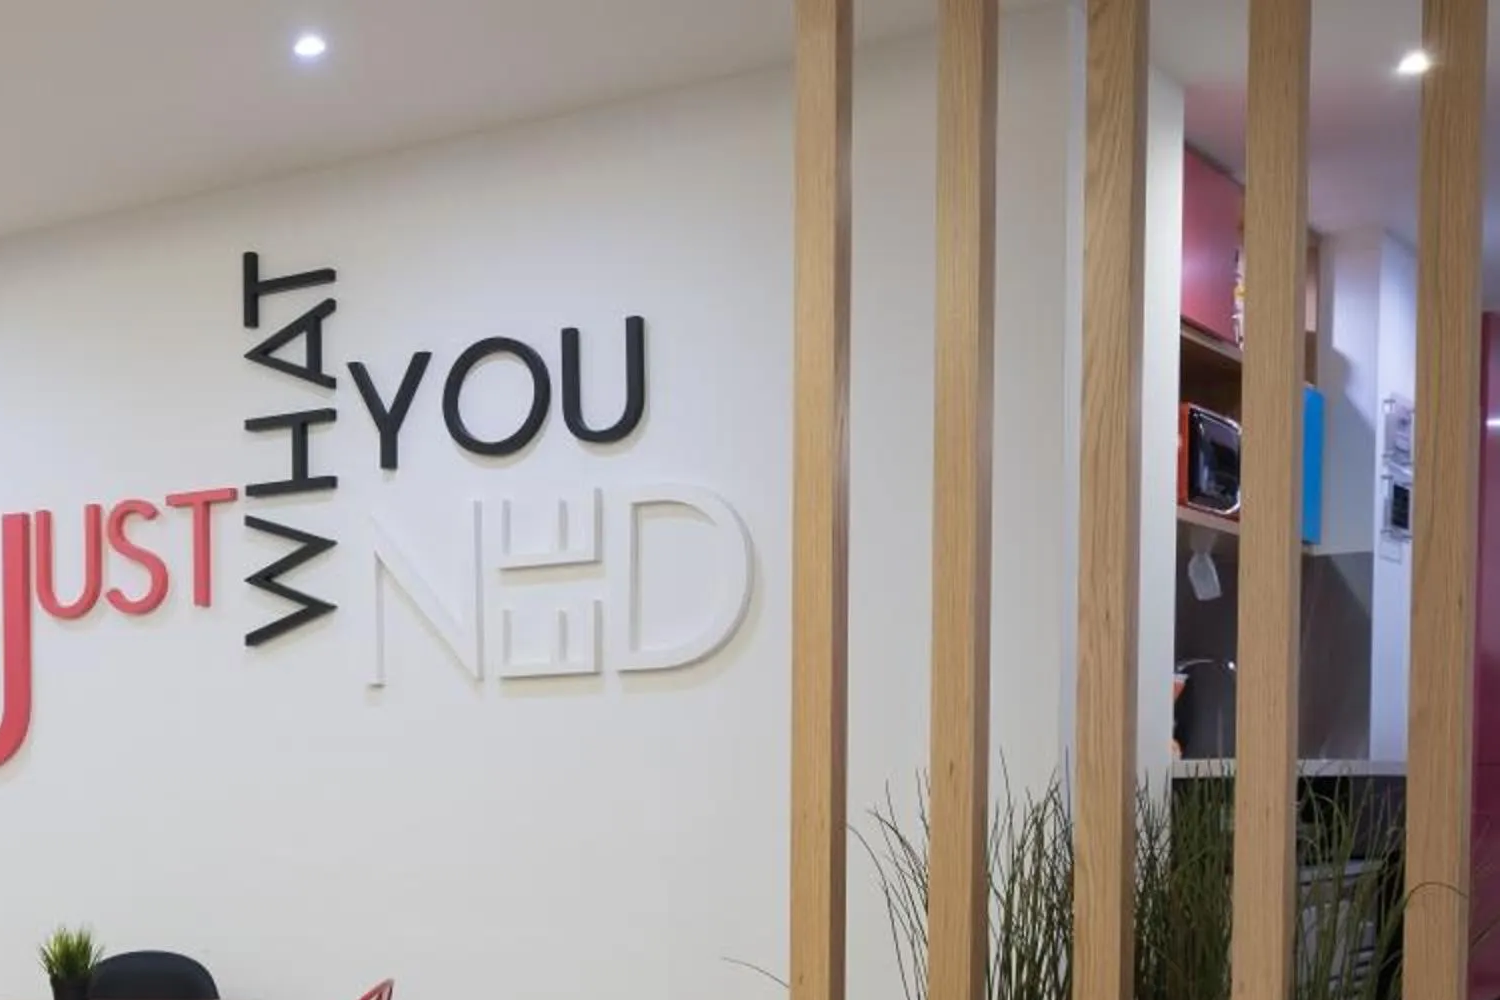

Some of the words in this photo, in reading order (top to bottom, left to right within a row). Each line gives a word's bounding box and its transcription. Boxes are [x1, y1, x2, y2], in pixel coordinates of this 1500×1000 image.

[243, 251, 337, 647] WHAT
[348, 315, 645, 470] YOU
[368, 482, 756, 688] NEED
